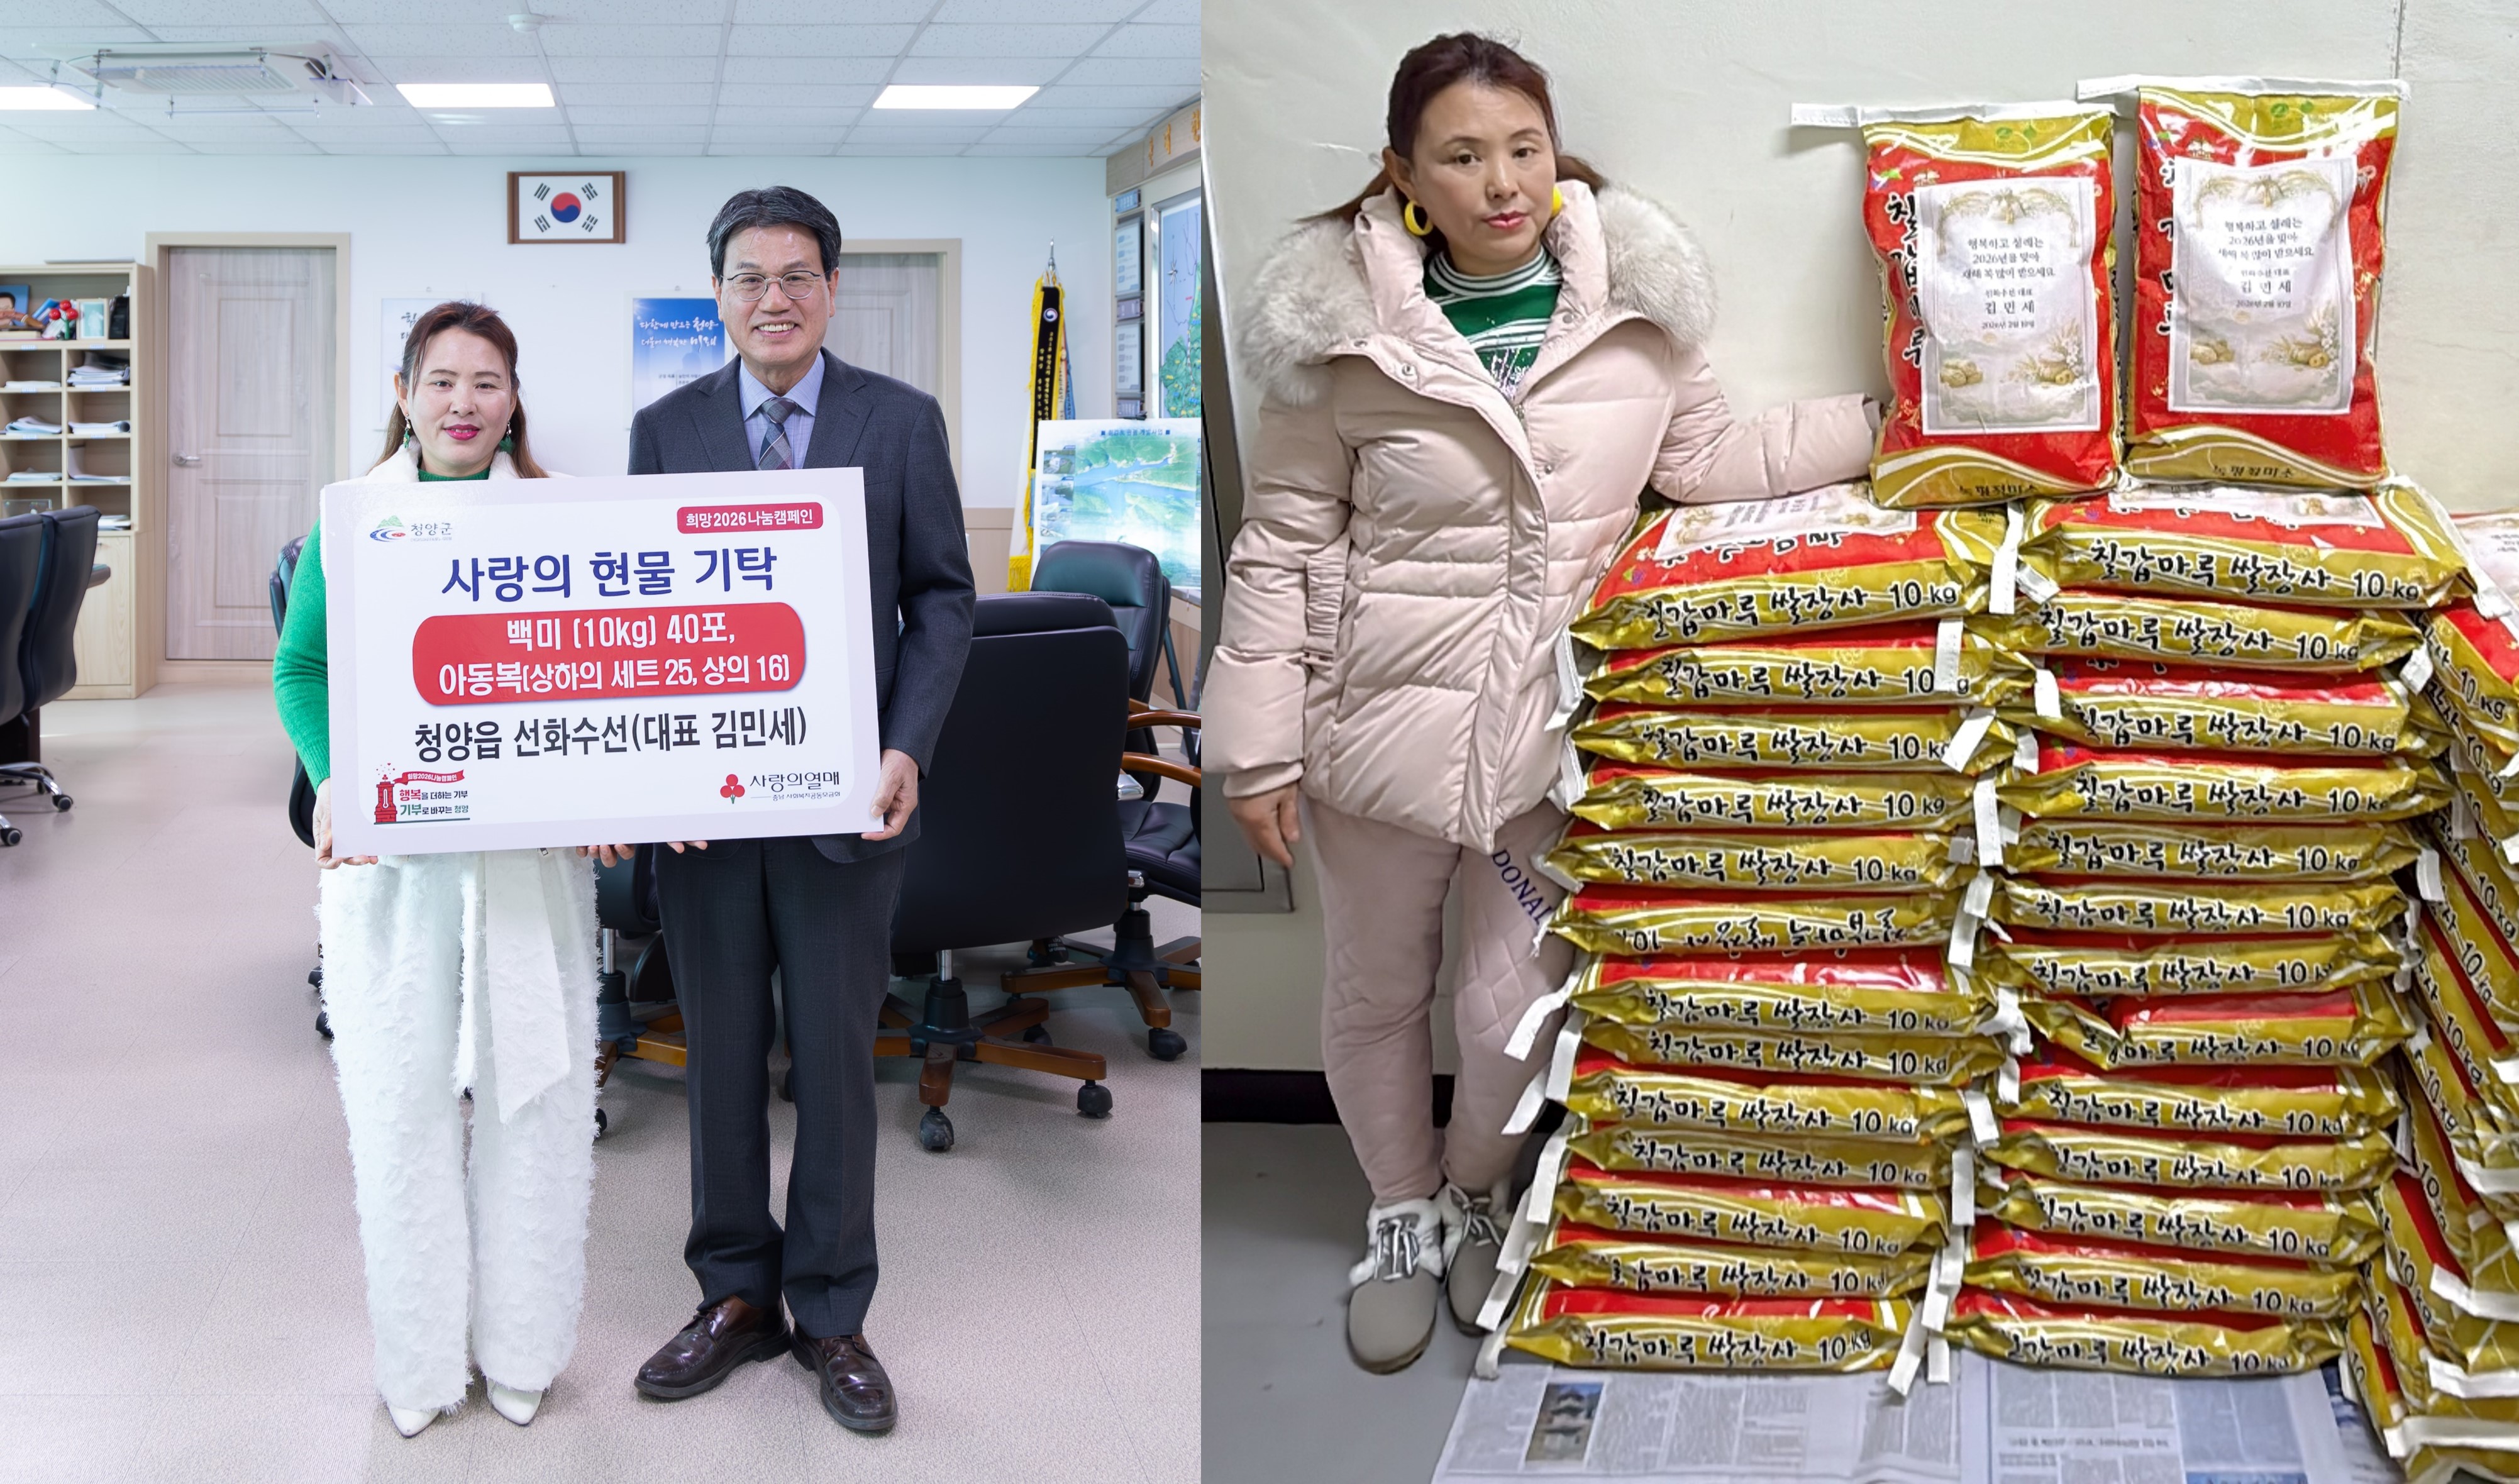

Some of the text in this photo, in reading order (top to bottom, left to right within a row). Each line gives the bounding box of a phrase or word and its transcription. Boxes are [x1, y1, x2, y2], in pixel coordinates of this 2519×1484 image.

[1973, 253, 2017, 264] 2026년을
[670, 319, 690, 329] 만드는
[411, 523, 453, 536] 청양군
[686, 509, 813, 528] 희망2026나눔캠페인
[442, 547, 777, 602] 사랑의 현물 기탁
[2091, 541, 2419, 601] 칠갑마루 쌀장사 10 kg
[1771, 587, 1869, 625] 쌀장사
[1889, 582, 1922, 609] 10
[1930, 585, 1957, 604] kg
[507, 612, 734, 651] 백미 (10kg) 40포,
[2039, 605, 2358, 661] 칠갑마루 쌀장사 10 kg
[439, 654, 790, 696] 아동복(상하의 세트 25, 상의 16)
[1785, 663, 1883, 698] 쌀장사
[1904, 669, 1934, 694] 10
[2460, 669, 2476, 703] 10
[415, 706, 806, 762] 청양읍 선화수선(대표 김민세)
[1771, 729, 1868, 764] 쌀장사
[1888, 736, 1920, 760] 10
[2208, 712, 2396, 752] 쌀장사 10 kg
[399, 789, 468, 802] 행복을 더하는 기부
[750, 772, 839, 793] 사랑의열매
[786, 791, 840, 800] 사회복지공동모금회
[2078, 771, 2359, 816] 칠갑마루 쌀장사 10
[400, 804, 429, 816] 기부로
[454, 805, 468, 813] 청양
[1766, 790, 1863, 825] 쌀장사
[1884, 794, 1915, 817] 10
[1922, 797, 1946, 816] kg
[1611, 848, 1883, 884] 칠갑마루 쌀장사 10
[2048, 831, 2165, 872] 칠갑마루
[2180, 841, 2274, 875] 쌀장사
[2296, 848, 2327, 872] 10
[2478, 875, 2496, 911] 10
[2169, 899, 2264, 931] 쌀장사
[2284, 905, 2316, 929] 10
[2162, 959, 2256, 992] 쌀장사
[2276, 962, 2306, 983] 10
[2462, 943, 2484, 977] 10
[1774, 999, 1868, 1029] 쌀장사
[1888, 1011, 1917, 1030] 10
[2191, 1036, 2332, 1061] 쌀장사 10
[2446, 1014, 2464, 1051] 10
[1777, 1039, 1869, 1070] 쌀장사
[1888, 1053, 1916, 1075] 10
[1615, 1083, 1727, 1124] 칠갑마루
[1739, 1100, 1831, 1131] 쌀장사
[1853, 1113, 1881, 1133] 10
[2174, 1100, 2314, 1134] 쌀장사 10
[1759, 1150, 1849, 1180] 쌀장사
[1868, 1163, 1897, 1183] 10
[2173, 1155, 2311, 1190] 쌀장사 10
[1732, 1211, 1821, 1246] 쌀장사
[1840, 1231, 1868, 1252] 10
[2157, 1209, 2249, 1247] 쌀장사
[2267, 1229, 2297, 1254] 10
[1722, 1261, 1859, 1297] 쌀장사 10
[2144, 1274, 2234, 1310] 쌀장사
[2252, 1290, 2281, 1312] 10
[1708, 1333, 1798, 1368] 쌀장사
[1819, 1338, 1847, 1363] 10
[2122, 1337, 2258, 1375] 쌀장사 10
